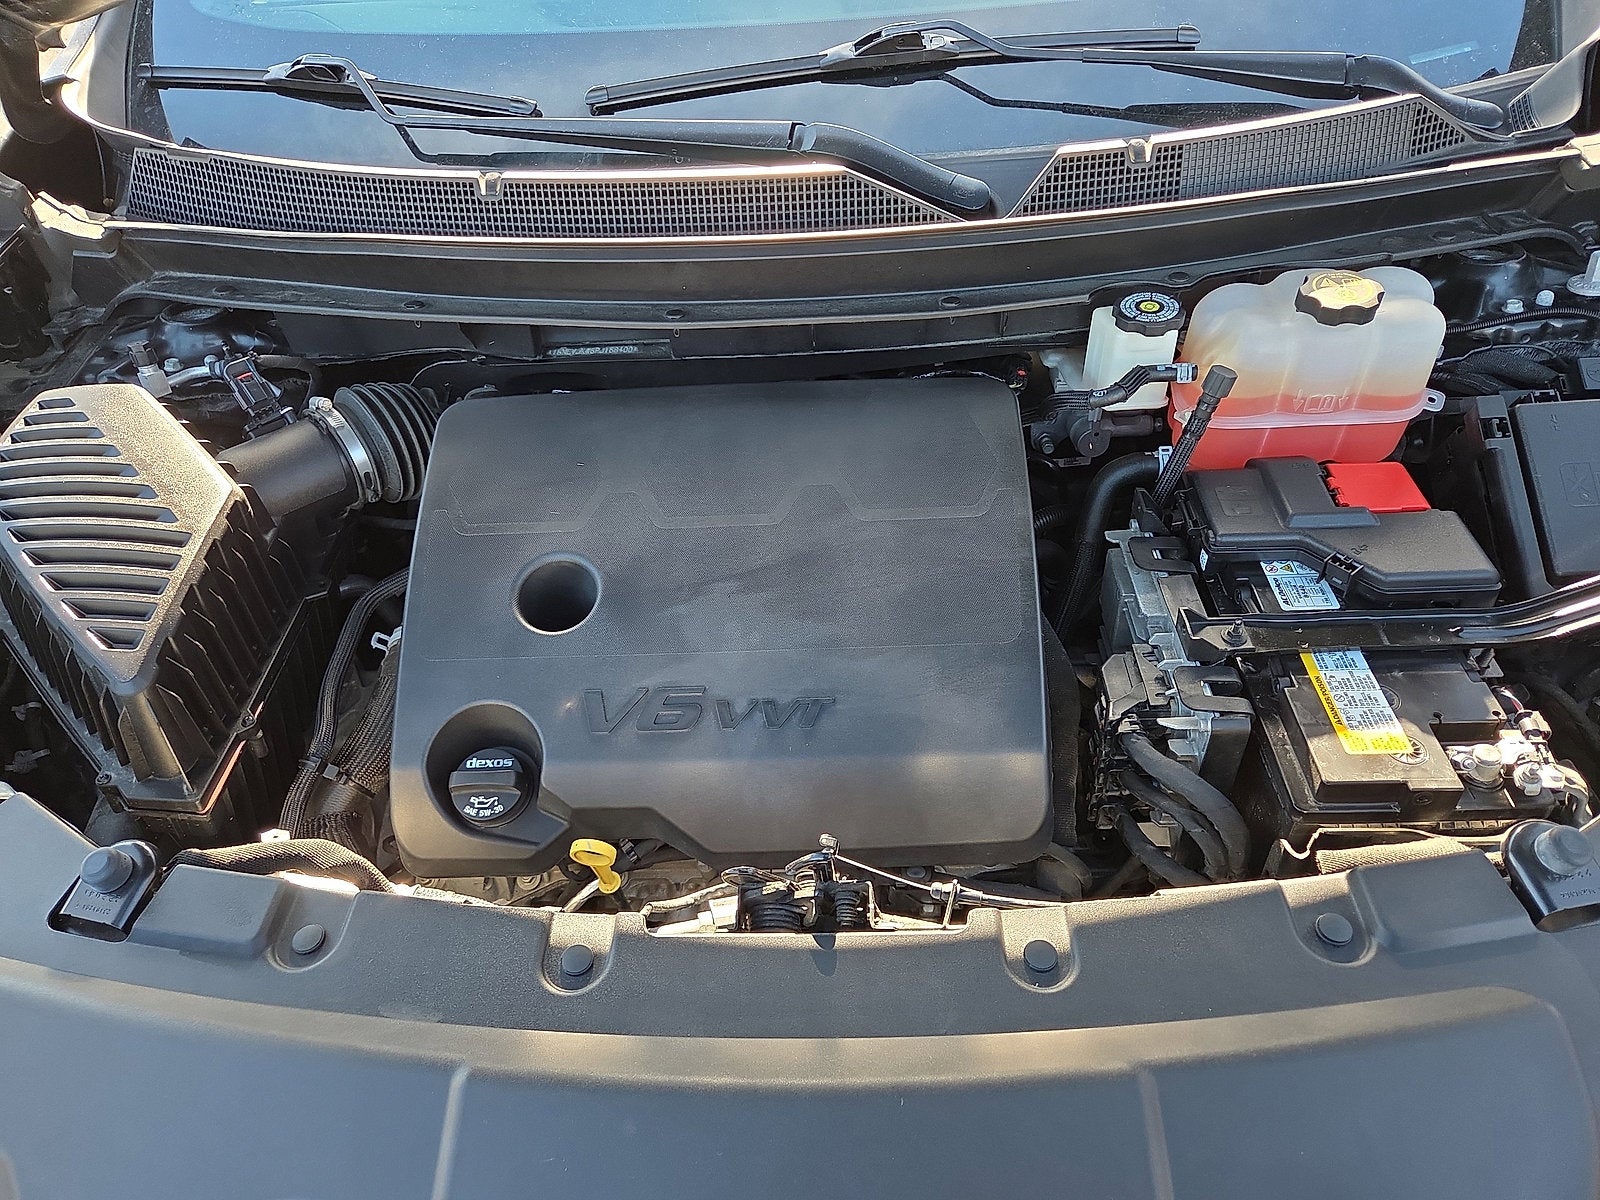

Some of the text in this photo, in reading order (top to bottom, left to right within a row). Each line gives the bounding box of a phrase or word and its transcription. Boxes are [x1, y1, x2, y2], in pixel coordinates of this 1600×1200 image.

[1272, 577, 1291, 607] ACDelco
[584, 686, 835, 734] V6 VVT
[465, 757, 514, 769] dexos
[463, 804, 504, 817] SAE 5W-30
